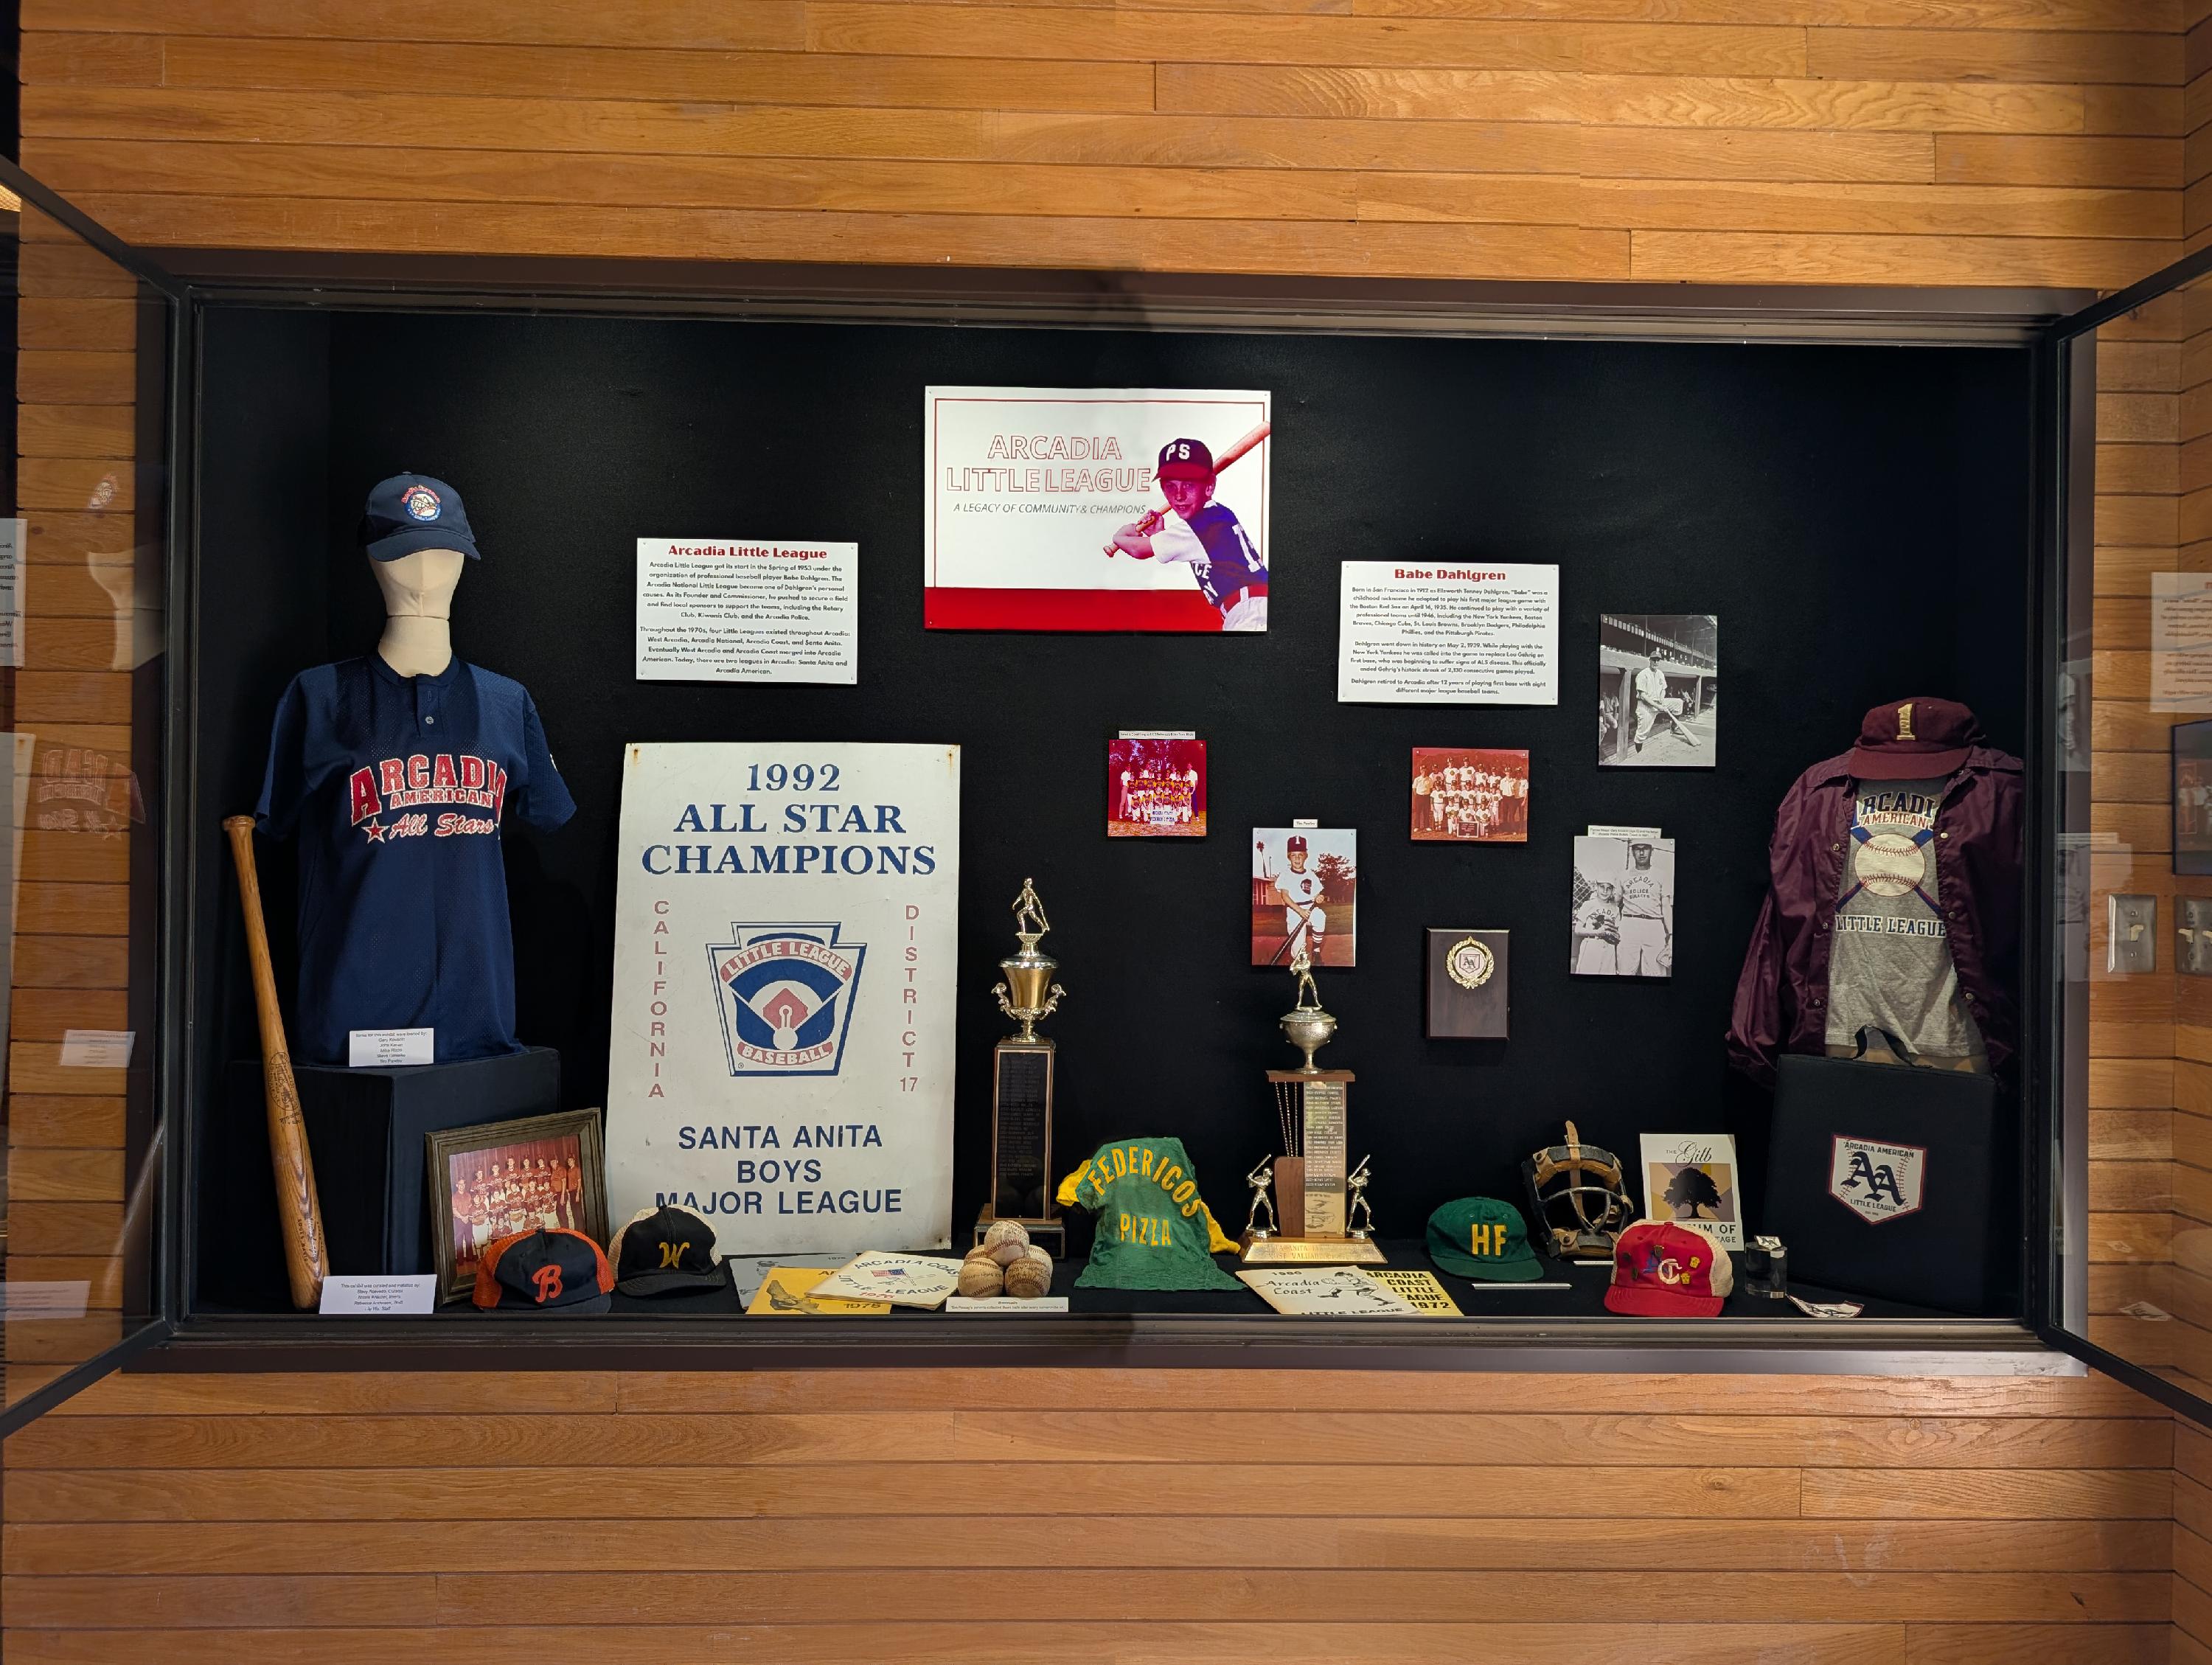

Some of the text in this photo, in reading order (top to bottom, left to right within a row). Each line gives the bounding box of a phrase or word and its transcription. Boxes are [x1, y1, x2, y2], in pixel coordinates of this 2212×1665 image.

[988, 435, 1122, 460] ARCADIA
[946, 467, 1150, 492] LITTLE LEAGUE
[953, 503, 960, 512] A
[963, 503, 1001, 512] LEGACY
[1002, 504, 1016, 513] OF
[1090, 504, 1146, 514] CHAMPIONS
[669, 546, 827, 560] Arcadia Little League
[1395, 569, 1506, 582] Babe Dahlgren
[1896, 703, 1916, 740] 1
[746, 764, 841, 792] 1992
[390, 788, 493, 810] AMERICAN
[1851, 792, 1938, 831] RCADI
[389, 813, 495, 840] All Stars
[674, 804, 906, 834] ALL STAR
[1860, 812, 1929, 829] AMERICAN
[641, 845, 936, 875] CHAMPIONS
[1836, 914, 1947, 938] LITTLE LEAGUE
[725, 942, 851, 976] LITTLE LEAGUE
[648, 900, 669, 1098] CALIFORNIA
[900, 905, 919, 1092] DISTRICT 17
[741, 1043, 830, 1066] BASEBALL
[678, 1125, 883, 1149] SANTA ANITA
[1844, 1142, 1914, 1158] ARCADIA AMERICAN
[737, 1159, 822, 1183] BOYS
[1088, 1146, 1202, 1217] FEDERICOS
[655, 1189, 902, 1214] MAJOR LEAGUE
[1850, 1198, 1897, 1212] LITTLE LEAGUE
[1120, 1213, 1171, 1246] PIZZA
[1471, 1224, 1508, 1256] HF
[1719, 1225, 1736, 1234] OF
[659, 1242, 689, 1269] W
[855, 1259, 923, 1269] ARCADIA
[532, 1265, 563, 1303] B
[886, 1285, 949, 1295] LEAGUE
[1256, 1279, 1320, 1287] Arcadia
